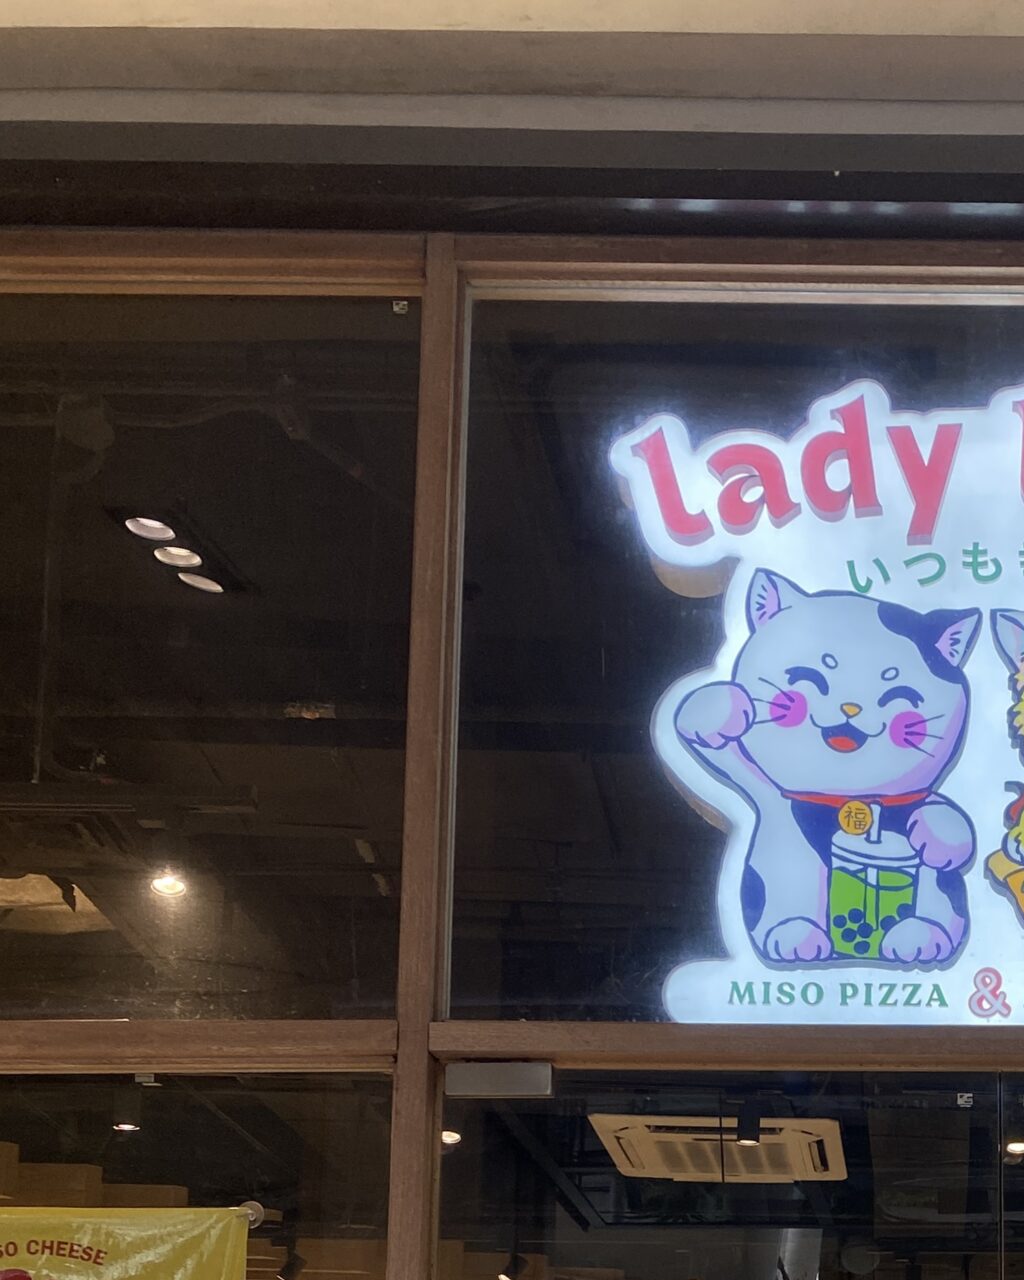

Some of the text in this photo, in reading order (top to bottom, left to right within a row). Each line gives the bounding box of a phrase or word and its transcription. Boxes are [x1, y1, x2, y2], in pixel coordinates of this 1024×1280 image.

[728, 980, 824, 1006] MISO
[839, 982, 949, 1008] PIZZA
[968, 967, 1012, 1018] &
[26, 1239, 108, 1265] CHEESE
